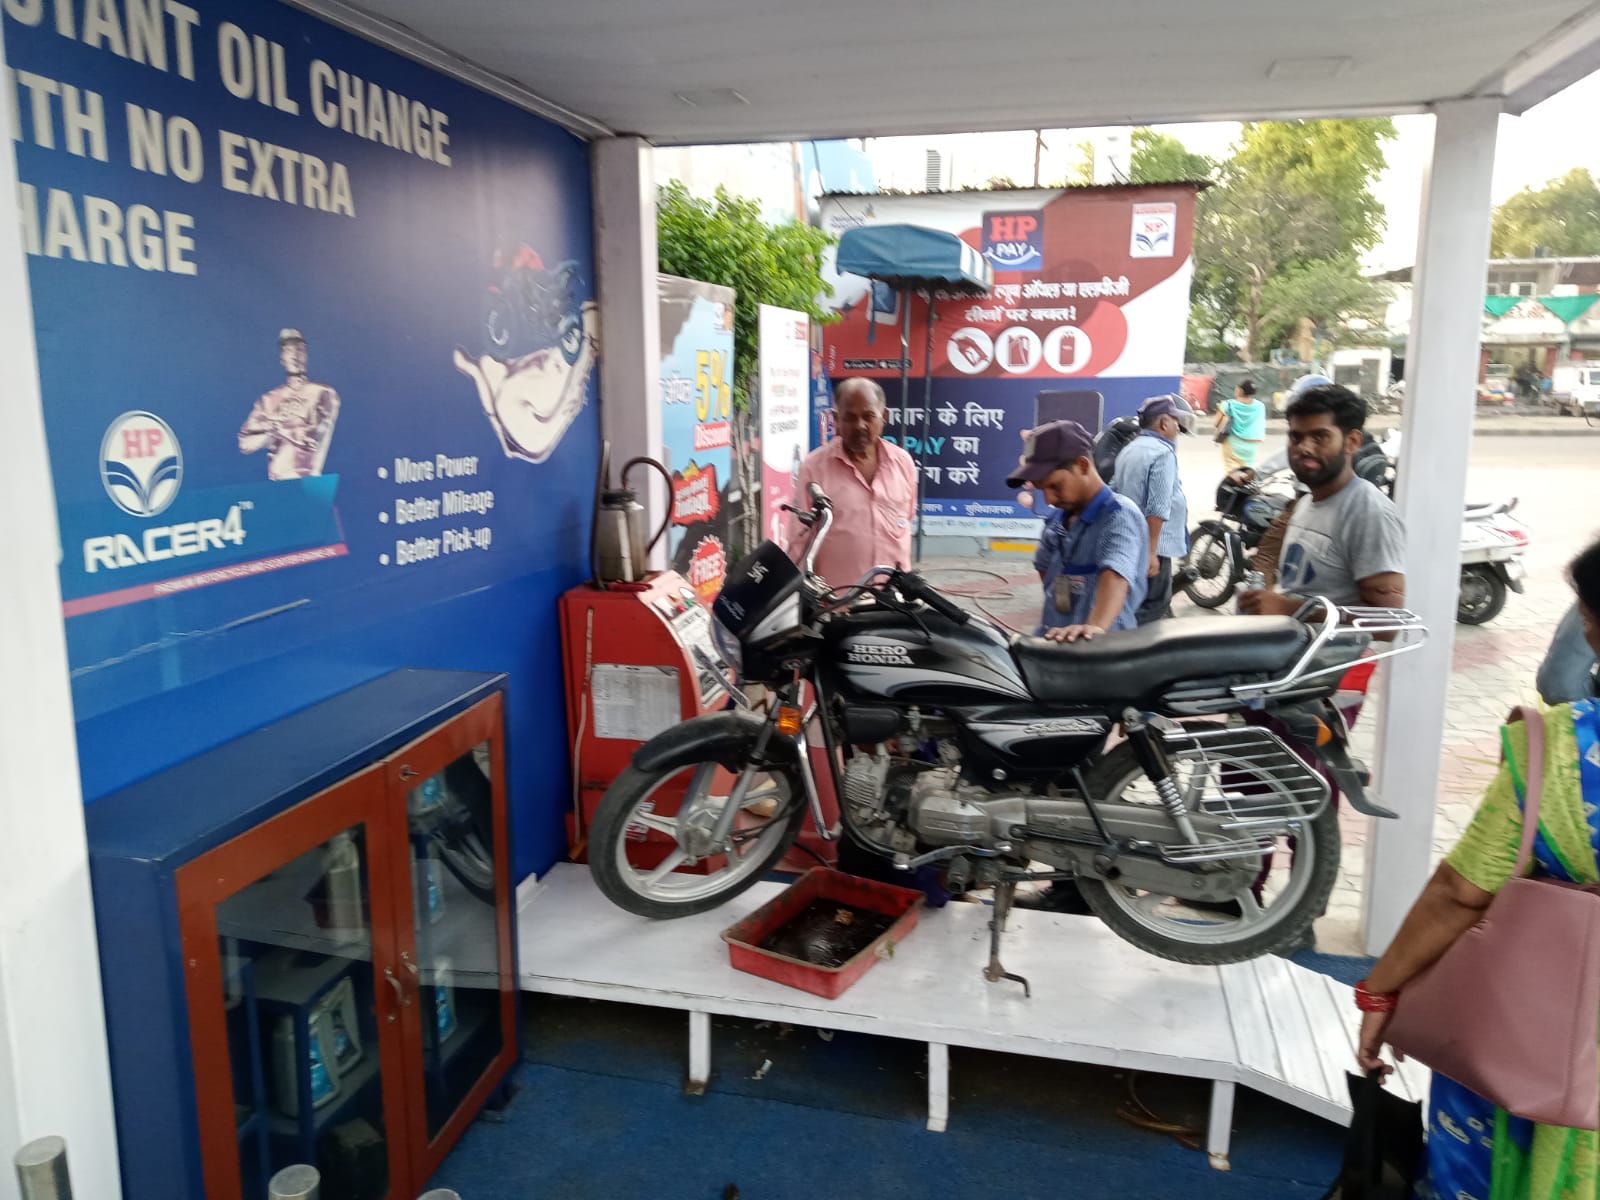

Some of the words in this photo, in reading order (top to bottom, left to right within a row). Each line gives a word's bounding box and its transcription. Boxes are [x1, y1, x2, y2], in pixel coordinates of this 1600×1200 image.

[3, 0, 200, 82] ANT
[218, 21, 299, 115] OIL
[309, 59, 451, 167] CHANGE
[126, 102, 204, 183] NO
[219, 129, 356, 218] EXTRA
[990, 215, 1037, 242] HP
[996, 241, 1027, 257] PAY
[936, 401, 958, 427] के
[962, 401, 1005, 431] लिए
[122, 428, 163, 458] HP
[951, 436, 980, 455] का
[395, 457, 435, 484] More
[436, 454, 479, 479] Power
[945, 461, 980, 485] करें
[396, 497, 440, 525] Better
[442, 490, 495, 516] Mileage
[396, 537, 440, 565] Better
[442, 527, 491, 554] Pick-up
[846, 652, 915, 665] HONDA
[851, 643, 908, 656] HERO
